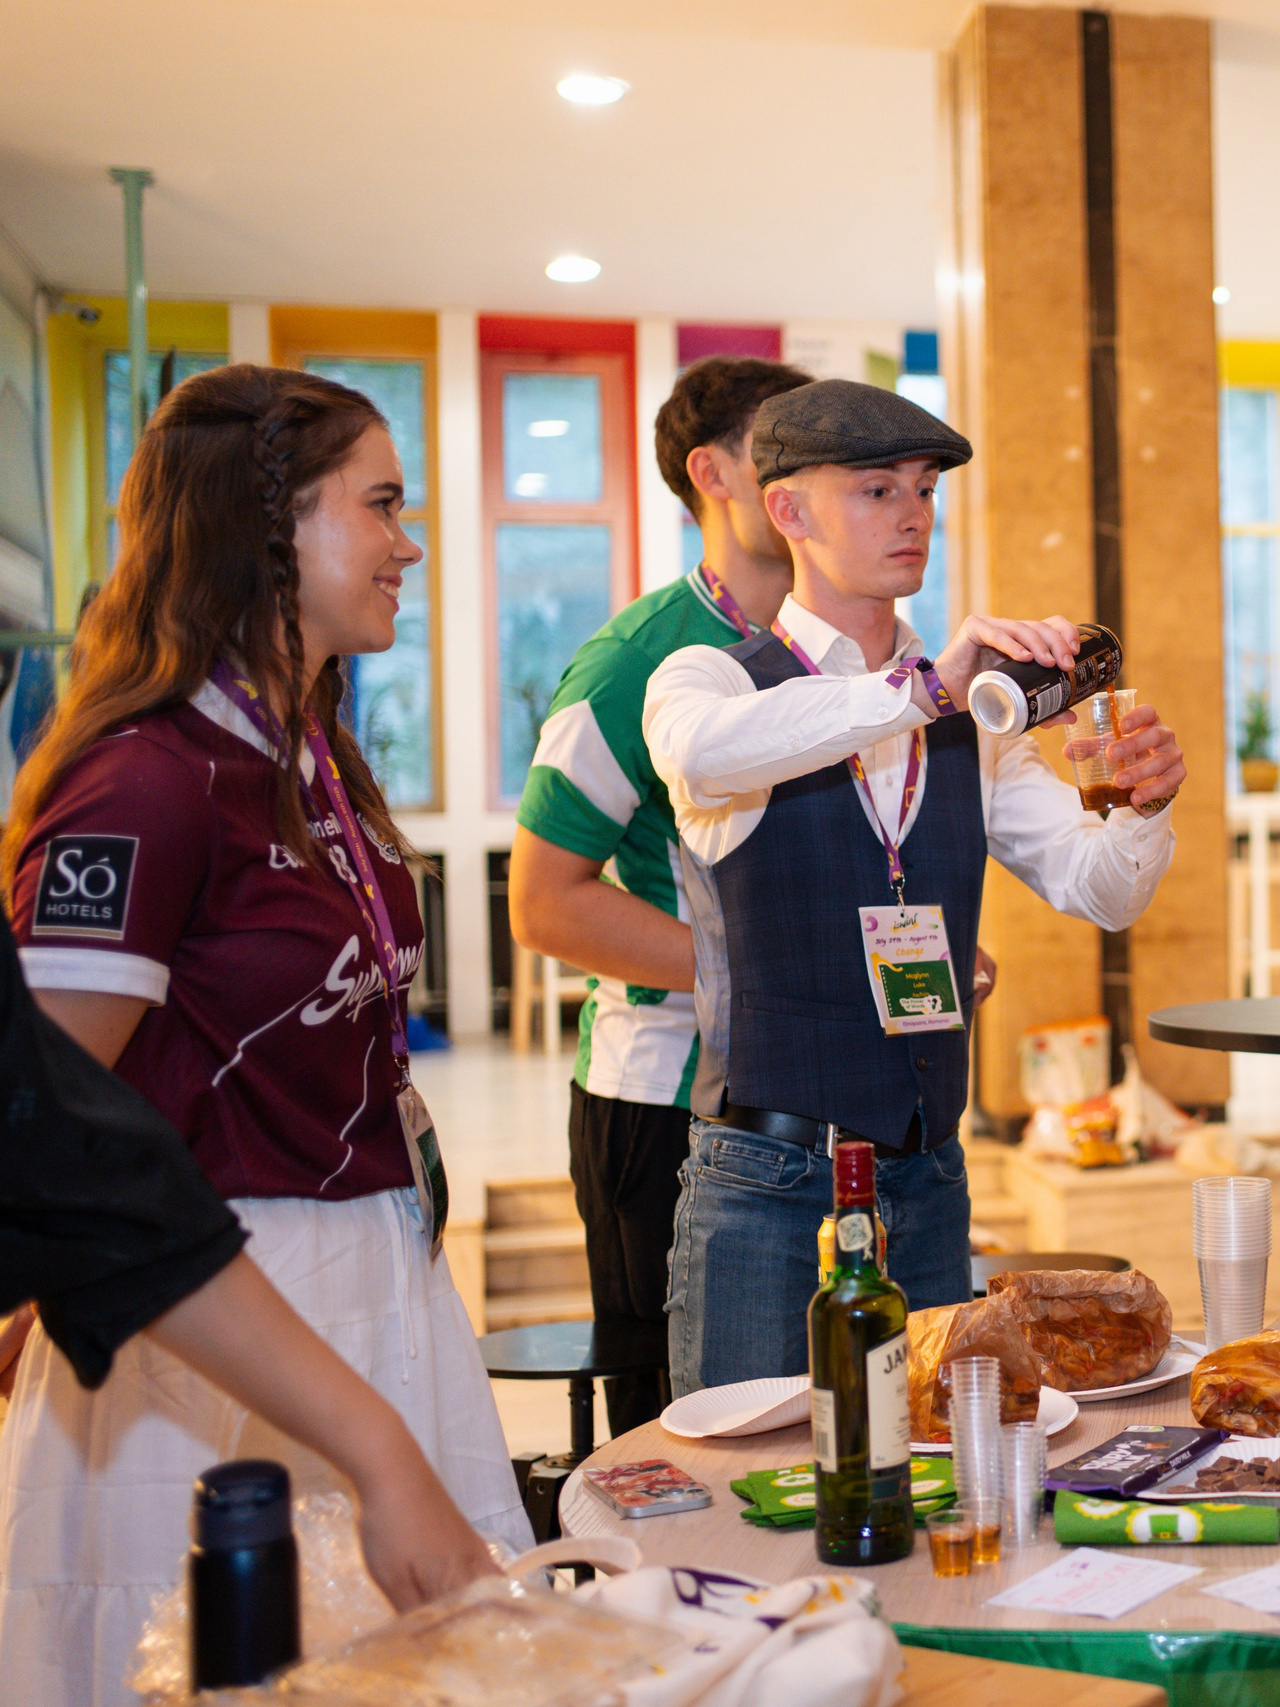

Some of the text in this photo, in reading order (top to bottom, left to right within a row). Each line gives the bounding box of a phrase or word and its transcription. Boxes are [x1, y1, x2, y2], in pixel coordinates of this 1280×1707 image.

[49, 849, 117, 899] Só
[46, 904, 113, 918] HOTELS
[896, 948, 924, 960] Change
